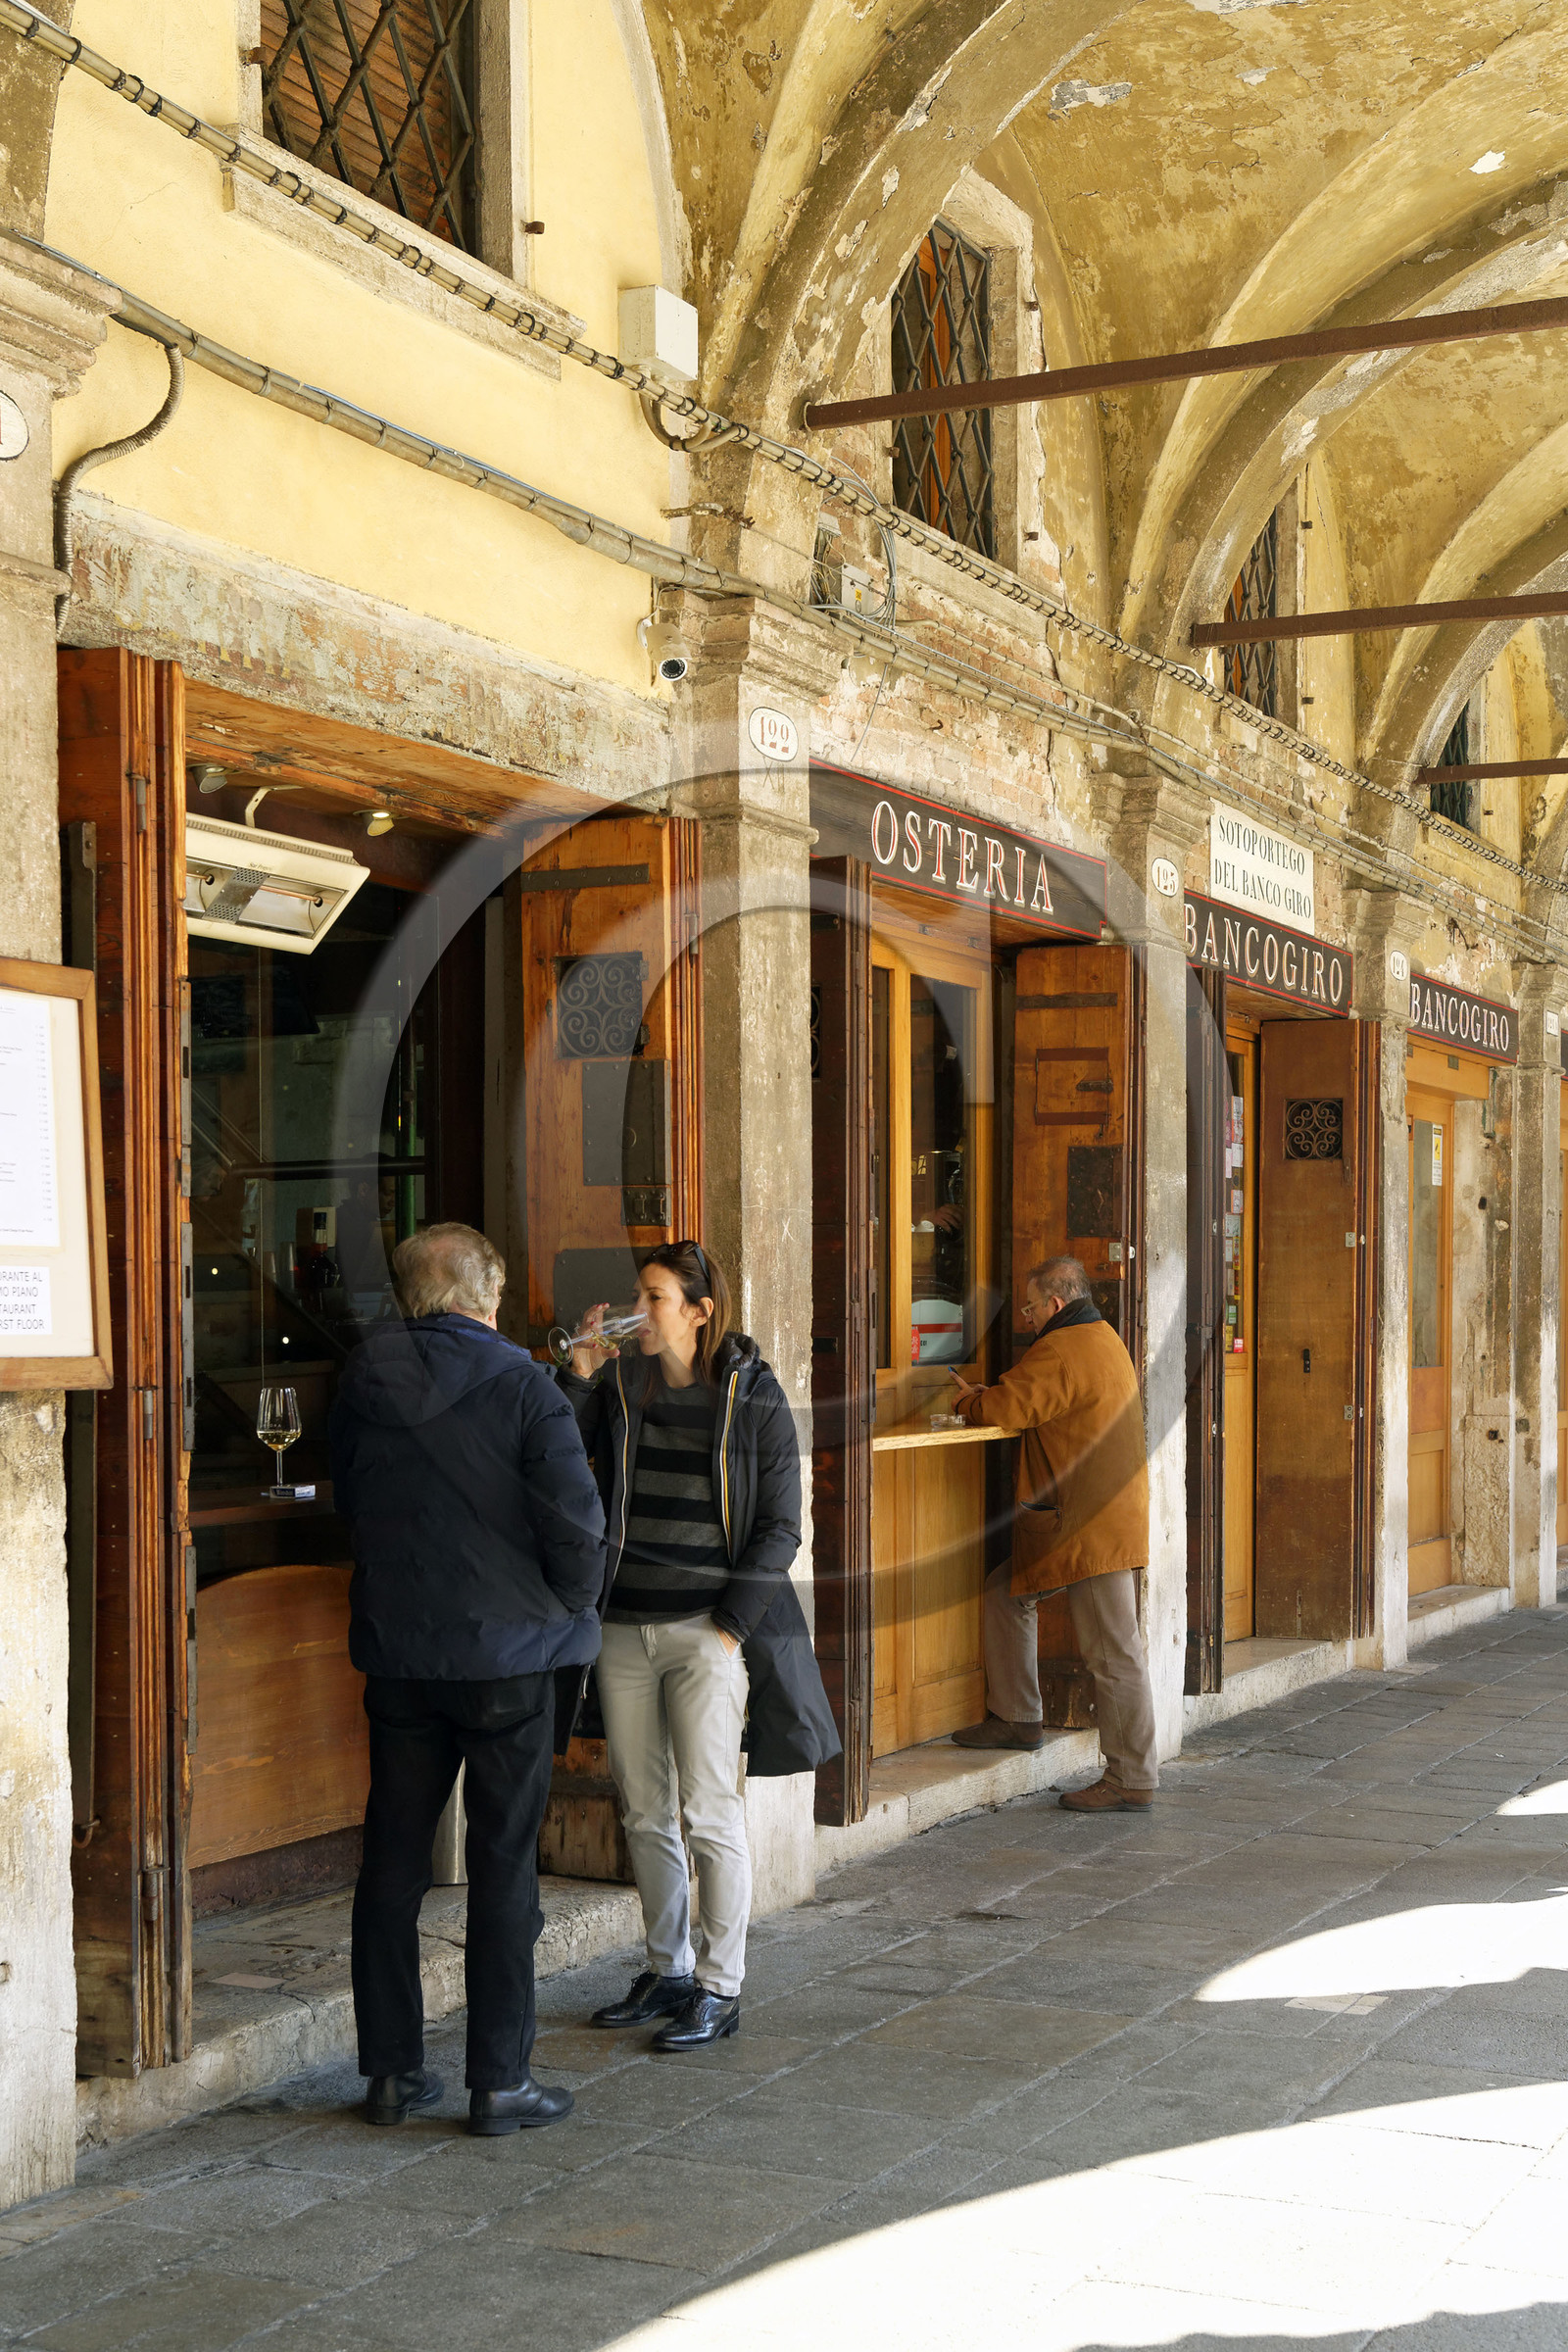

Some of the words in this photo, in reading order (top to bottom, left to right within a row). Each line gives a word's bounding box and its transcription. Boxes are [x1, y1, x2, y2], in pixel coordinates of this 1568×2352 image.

[871, 800, 1054, 915] OSTERIA
[1218, 814, 1305, 876] SOTOPORTEGO
[1214, 858, 1239, 893] DEL
[1242, 869, 1282, 908] BANCO
[1284, 886, 1311, 919] GIRO
[1184, 903, 1343, 1005] BANCOGIRO
[1411, 982, 1510, 1053] BANCOGIRO
[12, 1286, 38, 1298] PIANO
[32, 1271, 43, 1283] AL
[17, 1318, 45, 1330] FLOOR
